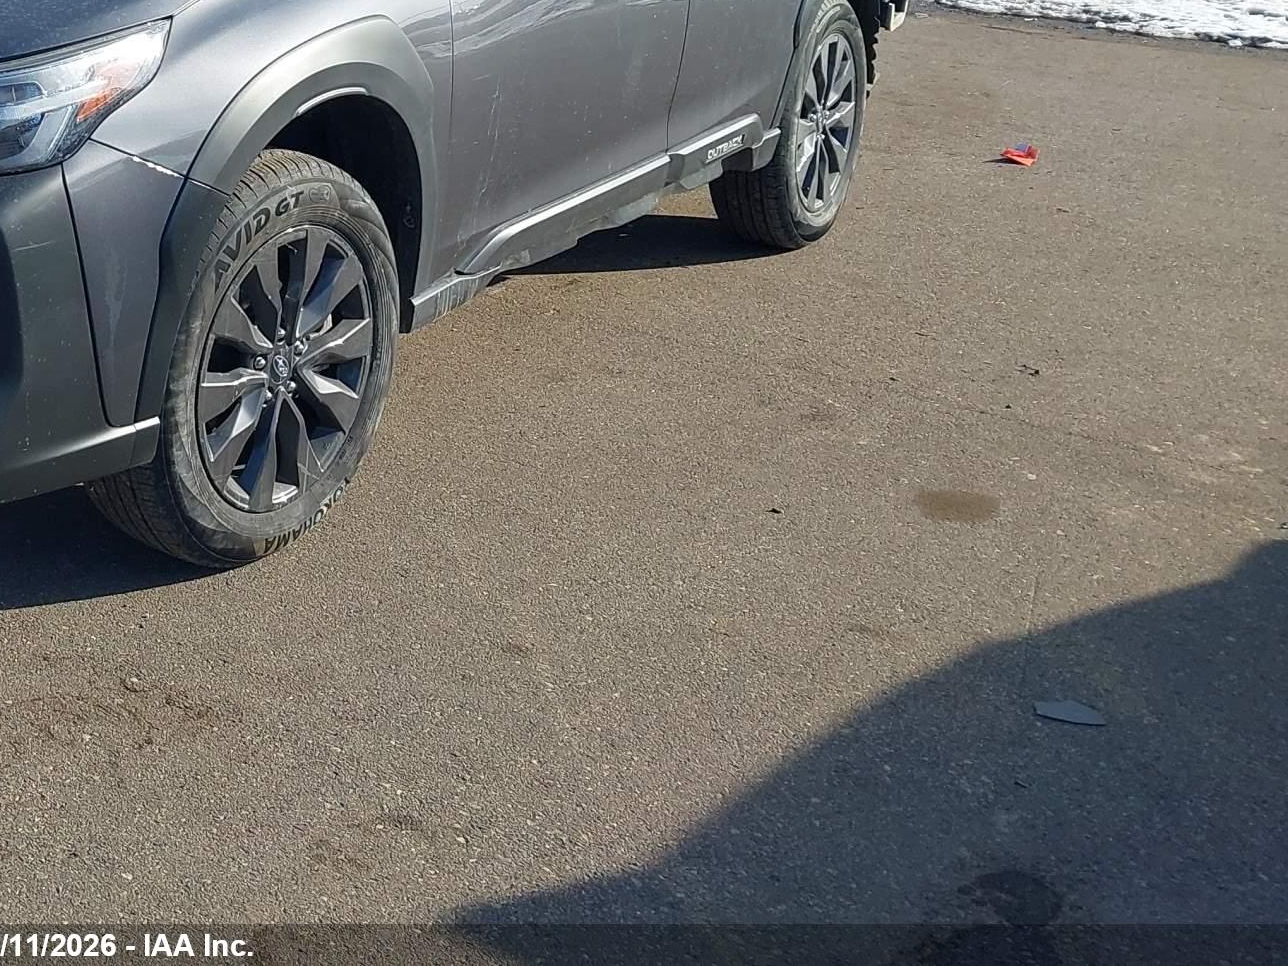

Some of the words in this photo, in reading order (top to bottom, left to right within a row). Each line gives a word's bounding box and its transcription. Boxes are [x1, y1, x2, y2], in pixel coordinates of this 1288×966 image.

[707, 134, 746, 160] OUTBACK
[214, 206, 272, 295] AVID
[274, 189, 305, 217] GT
